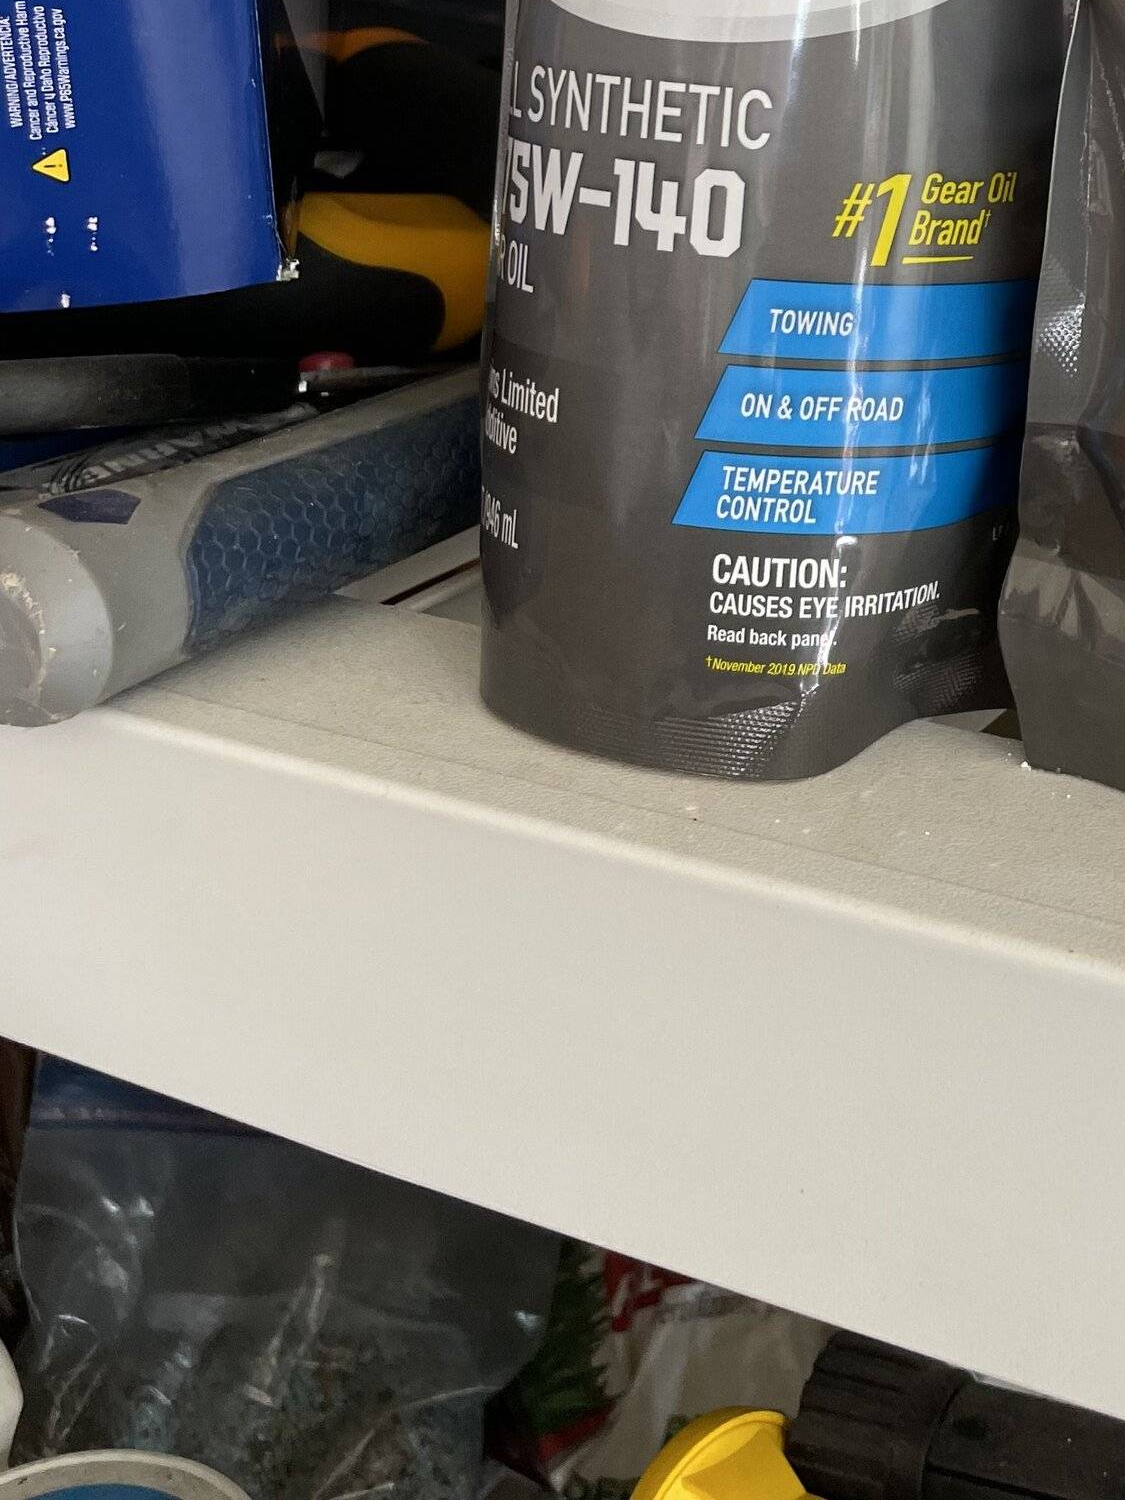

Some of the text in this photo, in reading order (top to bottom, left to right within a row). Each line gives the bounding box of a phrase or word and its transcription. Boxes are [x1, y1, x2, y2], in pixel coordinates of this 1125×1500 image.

[33, 5, 52, 67] Reproductivo
[14, 0, 42, 140] Cancer and Reproductive Harm
[528, 65, 773, 151] SYNTHETIC
[920, 171, 1018, 205] Gear Oil
[832, 173, 912, 267] #1
[507, 239, 534, 293] OIL
[768, 308, 855, 337] TOWING
[501, 368, 560, 423] Limited
[740, 393, 904, 422] ON & OFF ROAD
[721, 465, 880, 496] TEMPERATURE
[715, 494, 818, 525] CONTROL
[502, 509, 519, 549] mL
[712, 553, 848, 589] CAUTION:
[709, 580, 941, 619] CAUSES EYE IRRITATION.
[707, 624, 745, 645] Read
[749, 627, 787, 647] back
[767, 662, 796, 676] 2019
[822, 661, 847, 675] Data
